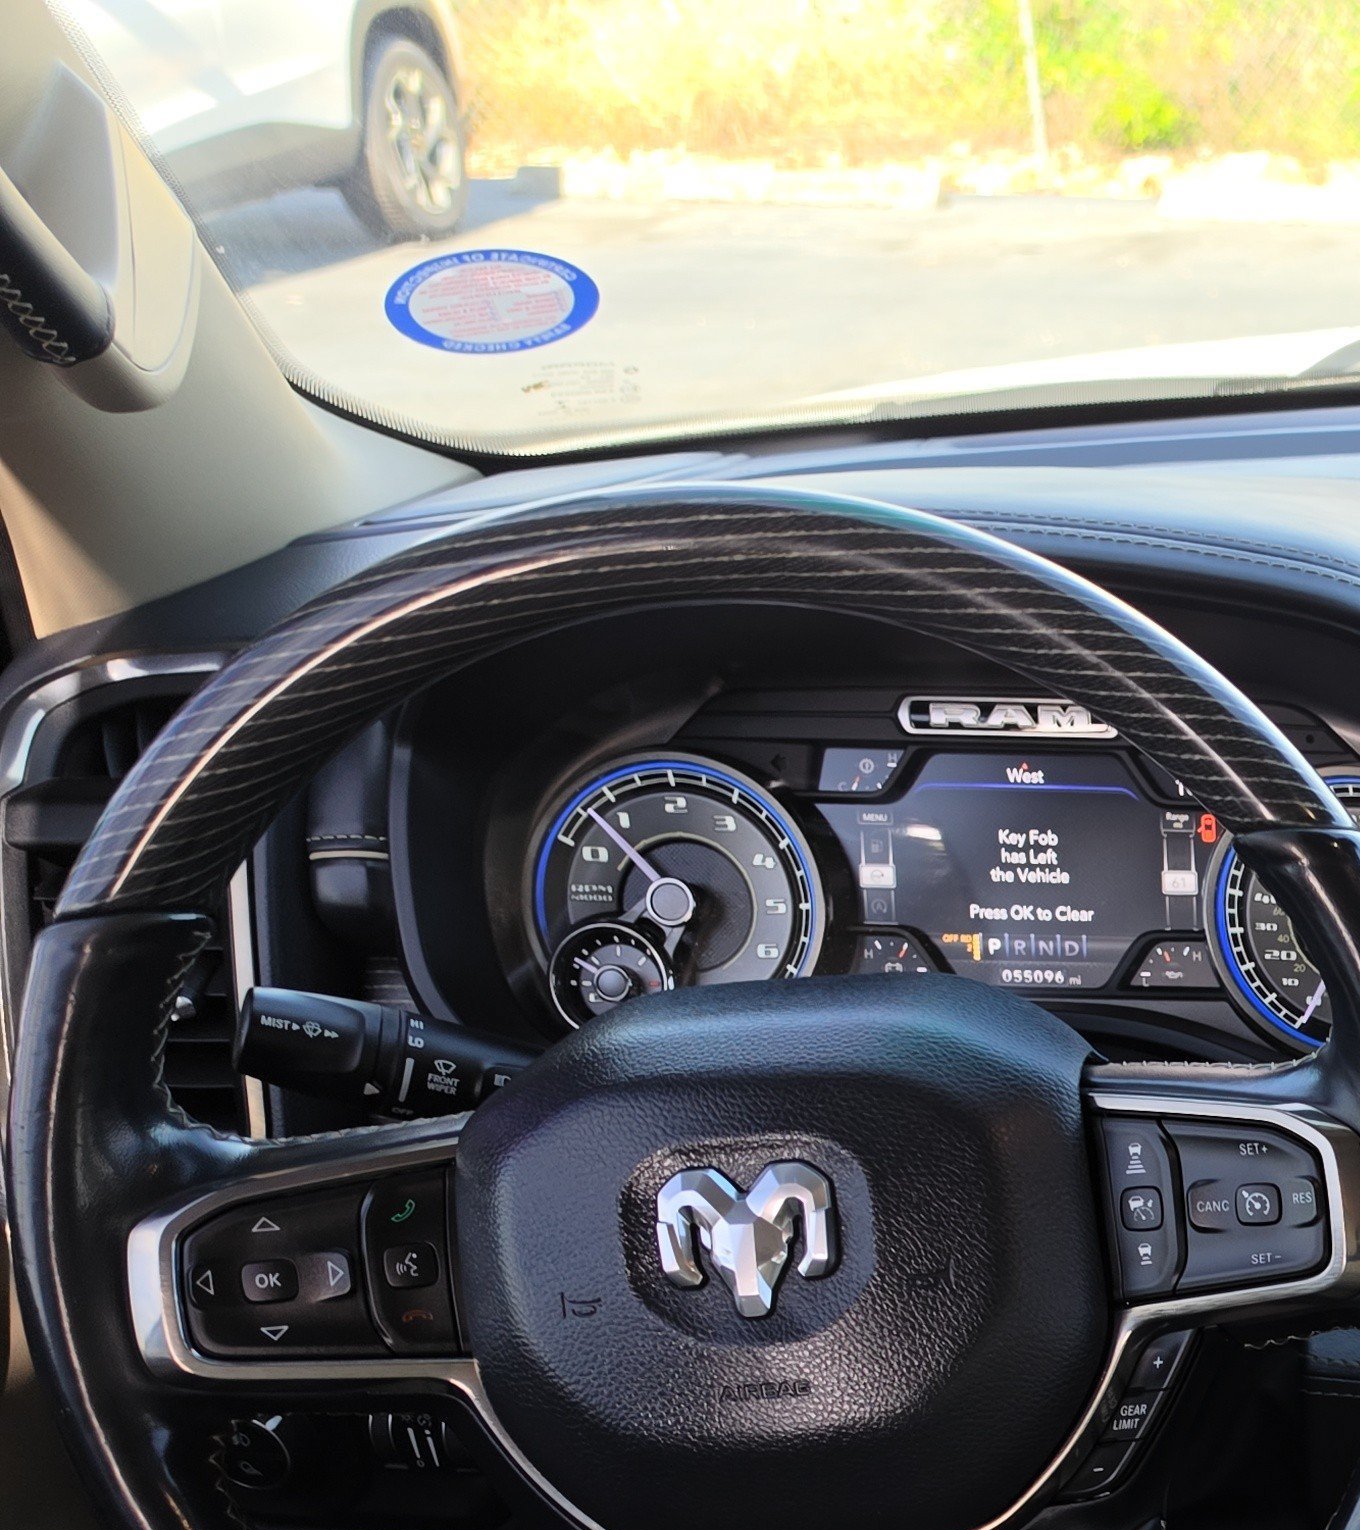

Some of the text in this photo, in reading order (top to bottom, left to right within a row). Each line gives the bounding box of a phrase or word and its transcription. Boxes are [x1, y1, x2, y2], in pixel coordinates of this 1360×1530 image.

[929, 703, 1091, 731] RAM
[1006, 768, 1045, 784] West
[664, 797, 688, 814] 2
[714, 815, 737, 832] 3
[998, 828, 1059, 848] Key Fob
[582, 846, 609, 862] 0
[752, 853, 776, 869] 4
[1001, 847, 1059, 865] has Left
[989, 866, 1070, 884] the Vehicle
[765, 899, 787, 915] 5
[969, 903, 1095, 922] Press OK to Clear
[756, 943, 779, 959] 6
[987, 937, 1080, 957] P R N D
[1264, 949, 1297, 961] 20
[1001, 969, 1082, 986] 055096 mi
[260, 1015, 291, 1031] MIST
[410, 1018, 425, 1030] HI
[407, 1035, 425, 1049] LO
[427, 1072, 460, 1087] FRONT
[1196, 1200, 1230, 1213] CANC
[1292, 1191, 1313, 1206] RES
[255, 1272, 282, 1289] OK
[1120, 1404, 1147, 1417] GEAR
[1113, 1417, 1140, 1431] LIMIT
